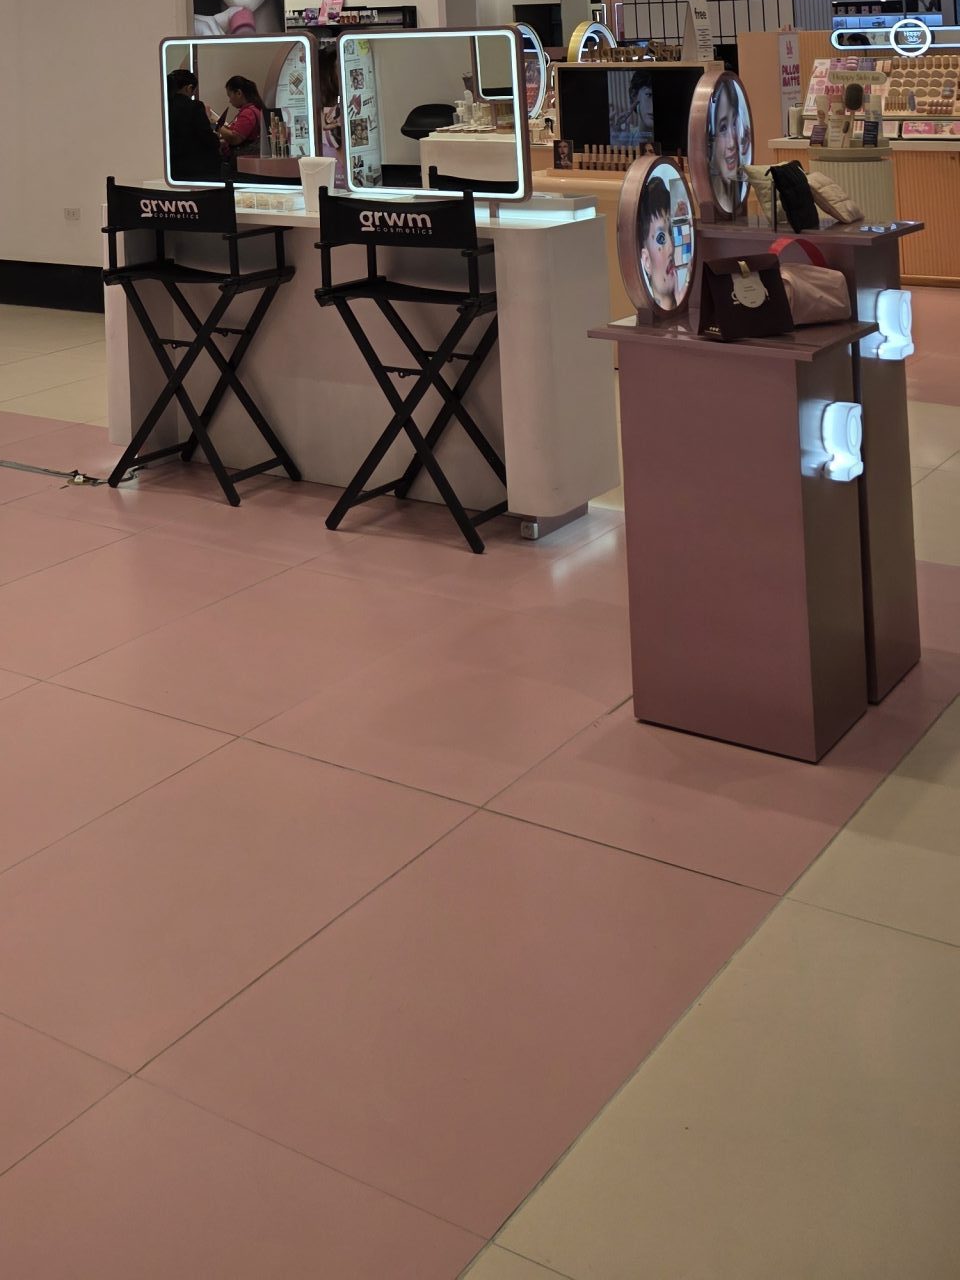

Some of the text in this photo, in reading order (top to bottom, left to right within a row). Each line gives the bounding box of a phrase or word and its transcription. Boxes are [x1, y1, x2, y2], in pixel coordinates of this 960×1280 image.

[140, 199, 198, 218] grwm
[153, 212, 199, 220] cosmetics
[359, 210, 432, 232] grwm
[376, 227, 433, 235] cosmetics
